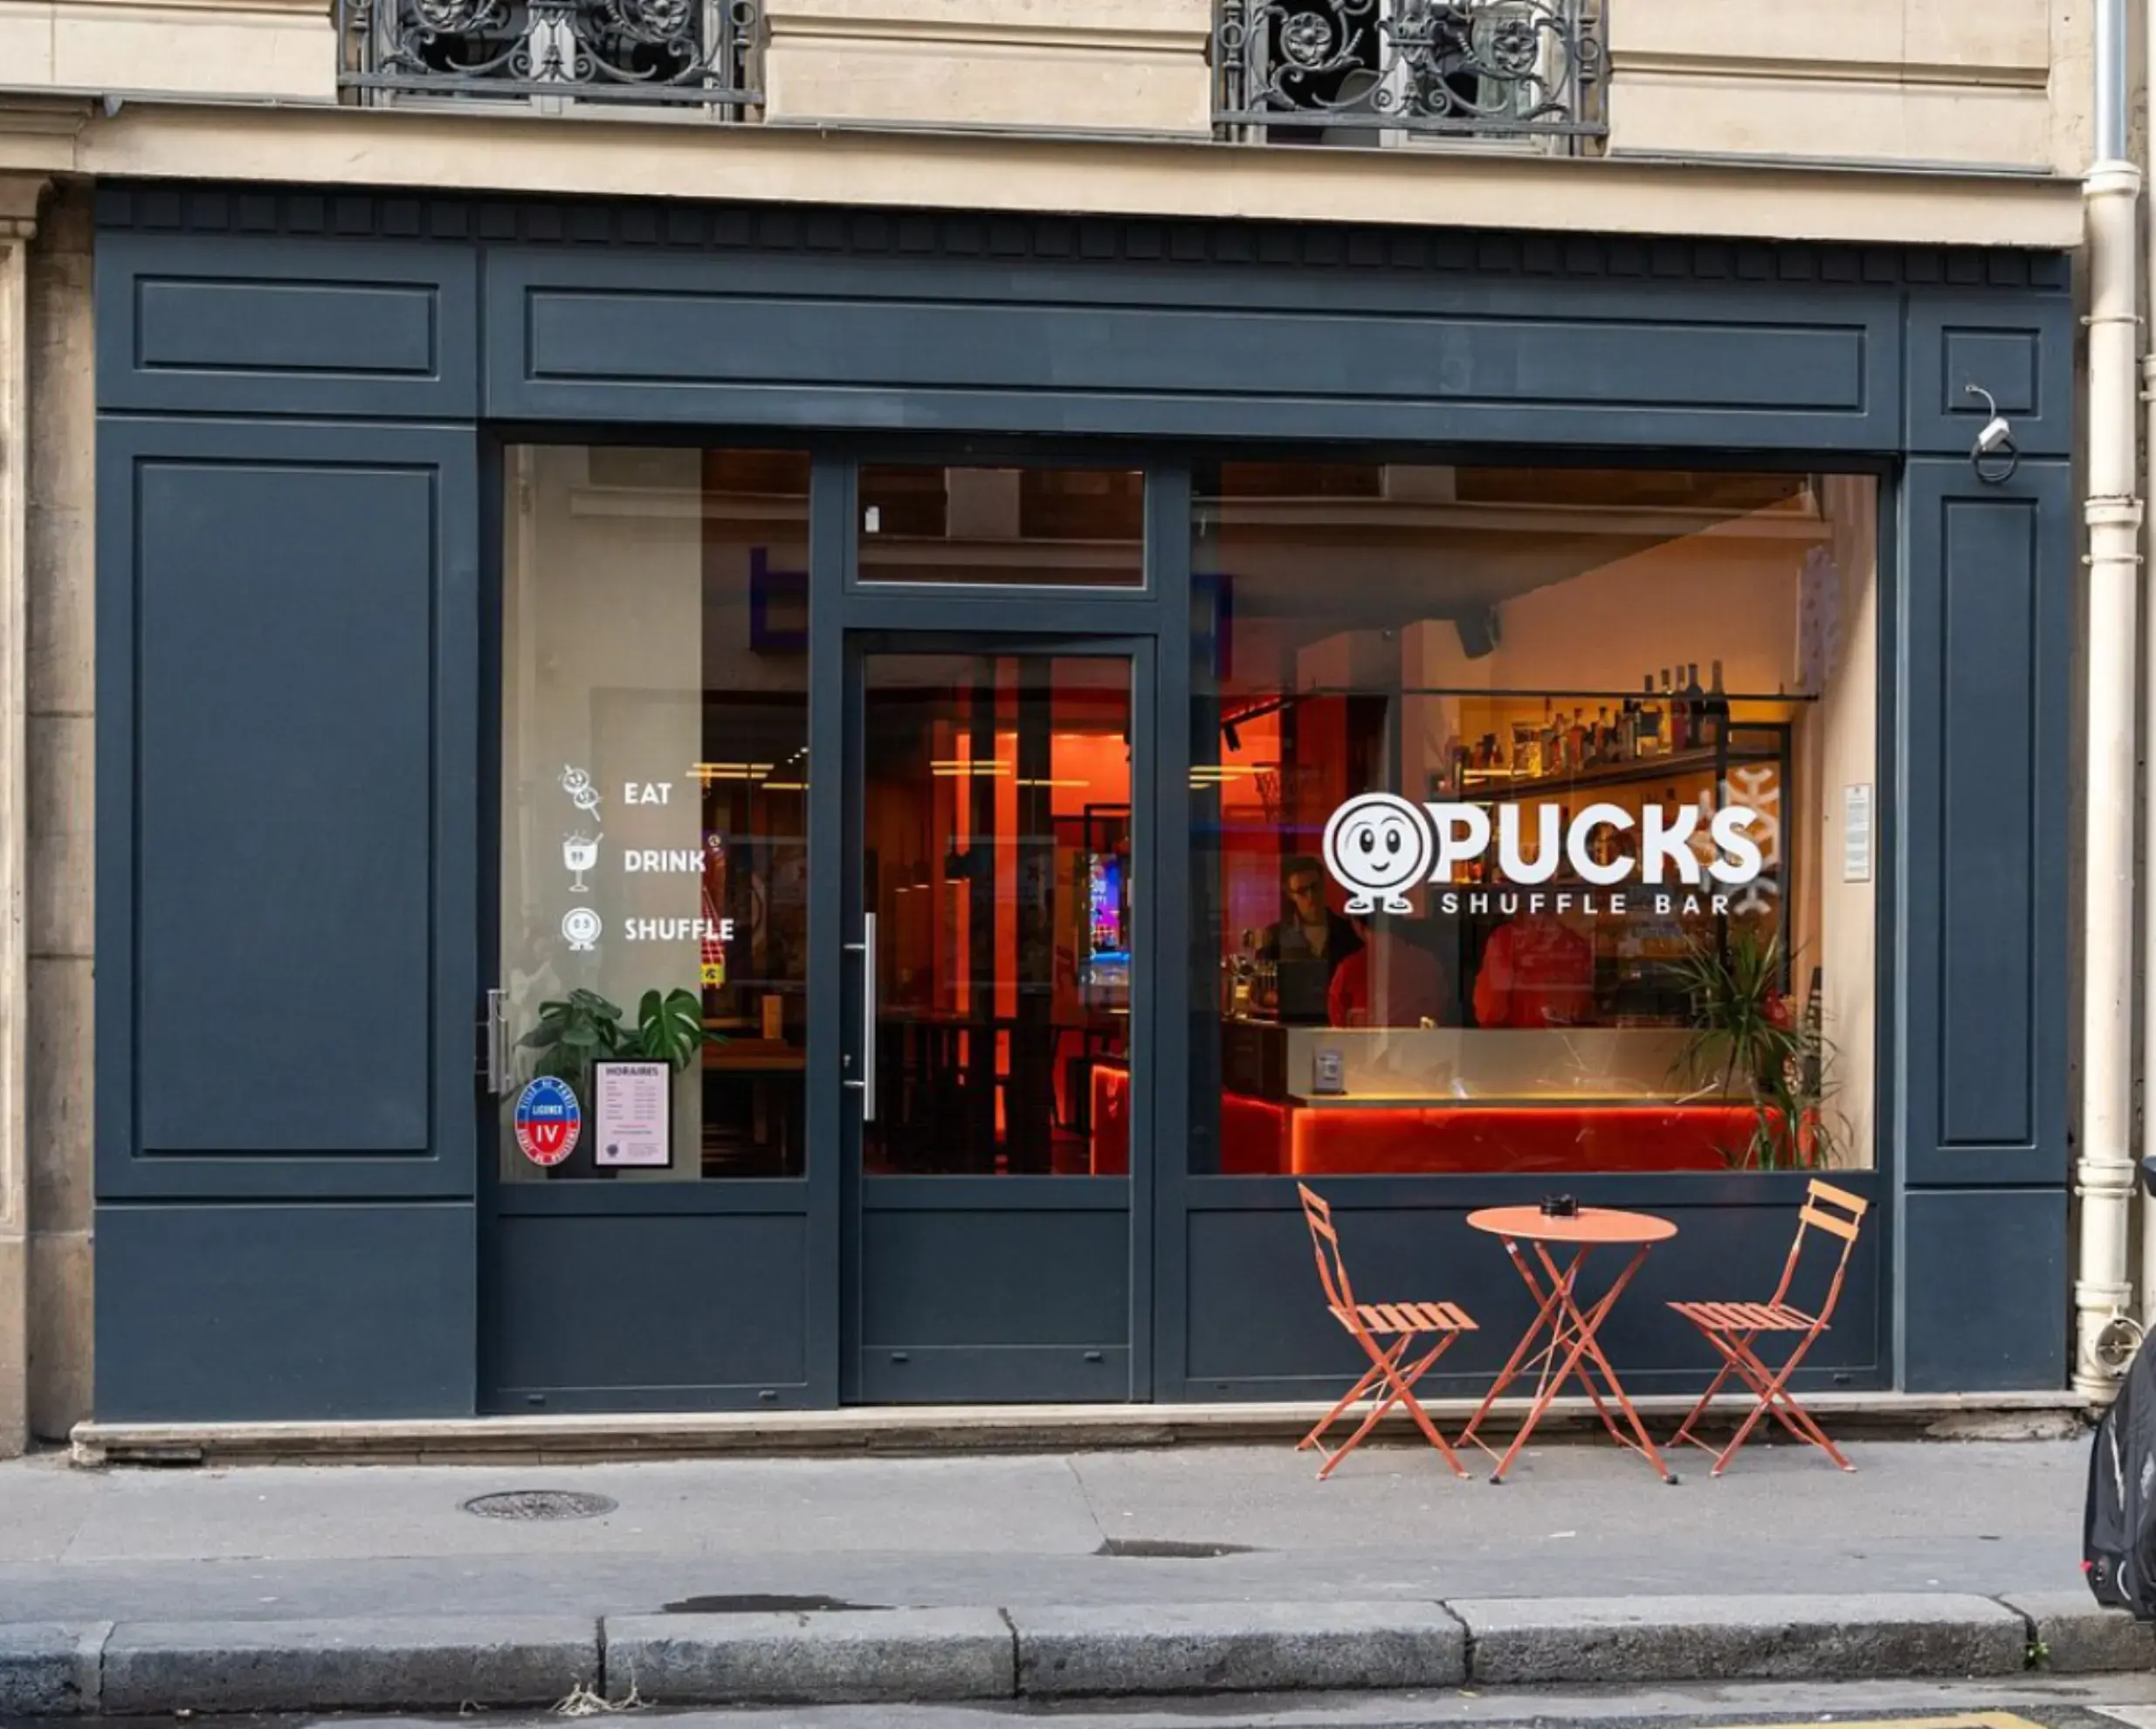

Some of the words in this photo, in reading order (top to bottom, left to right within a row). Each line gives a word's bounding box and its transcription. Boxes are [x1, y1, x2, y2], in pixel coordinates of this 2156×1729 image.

[625, 782, 672, 804] EAT
[1424, 803, 1762, 884] PUCKS
[625, 850, 706, 872] DRINK
[1442, 892, 1626, 914] SHUFFLE
[1656, 893, 1729, 914] BAR
[625, 918, 735, 940] SHUFFLE
[536, 1124, 559, 1143] IV
